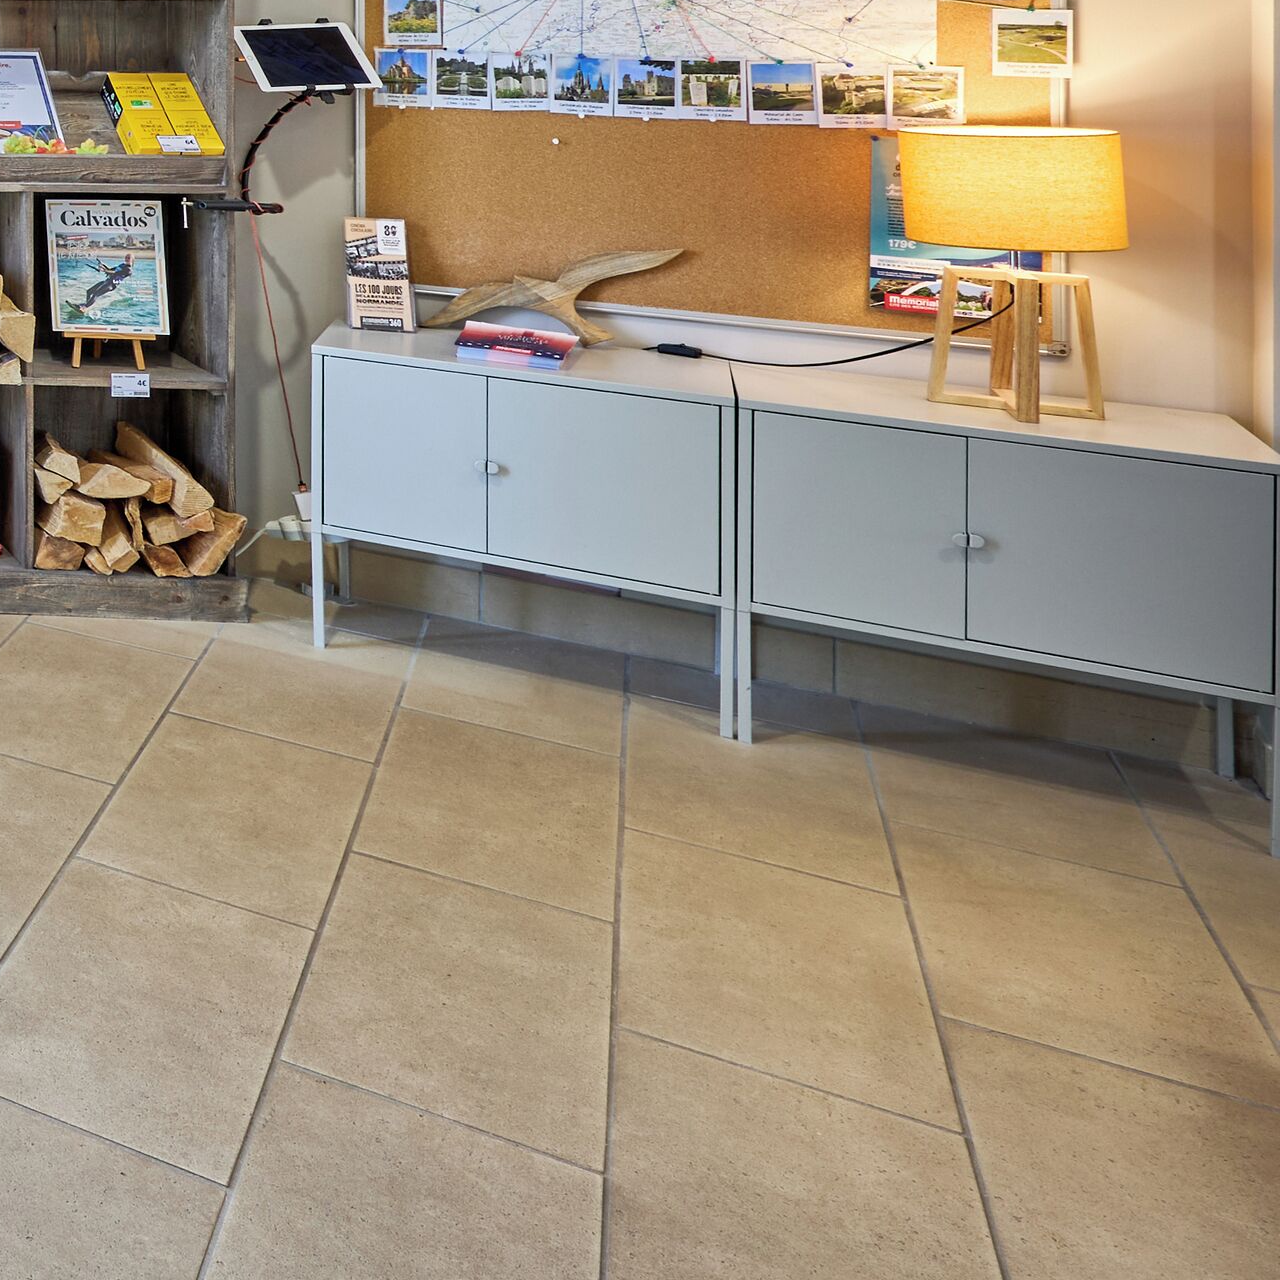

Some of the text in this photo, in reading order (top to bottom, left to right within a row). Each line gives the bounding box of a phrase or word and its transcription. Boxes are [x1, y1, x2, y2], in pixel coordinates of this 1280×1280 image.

[60, 210, 148, 228] Calvados
[888, 239, 917, 249] 179€
[355, 284, 402, 295] LES 100 JOURS
